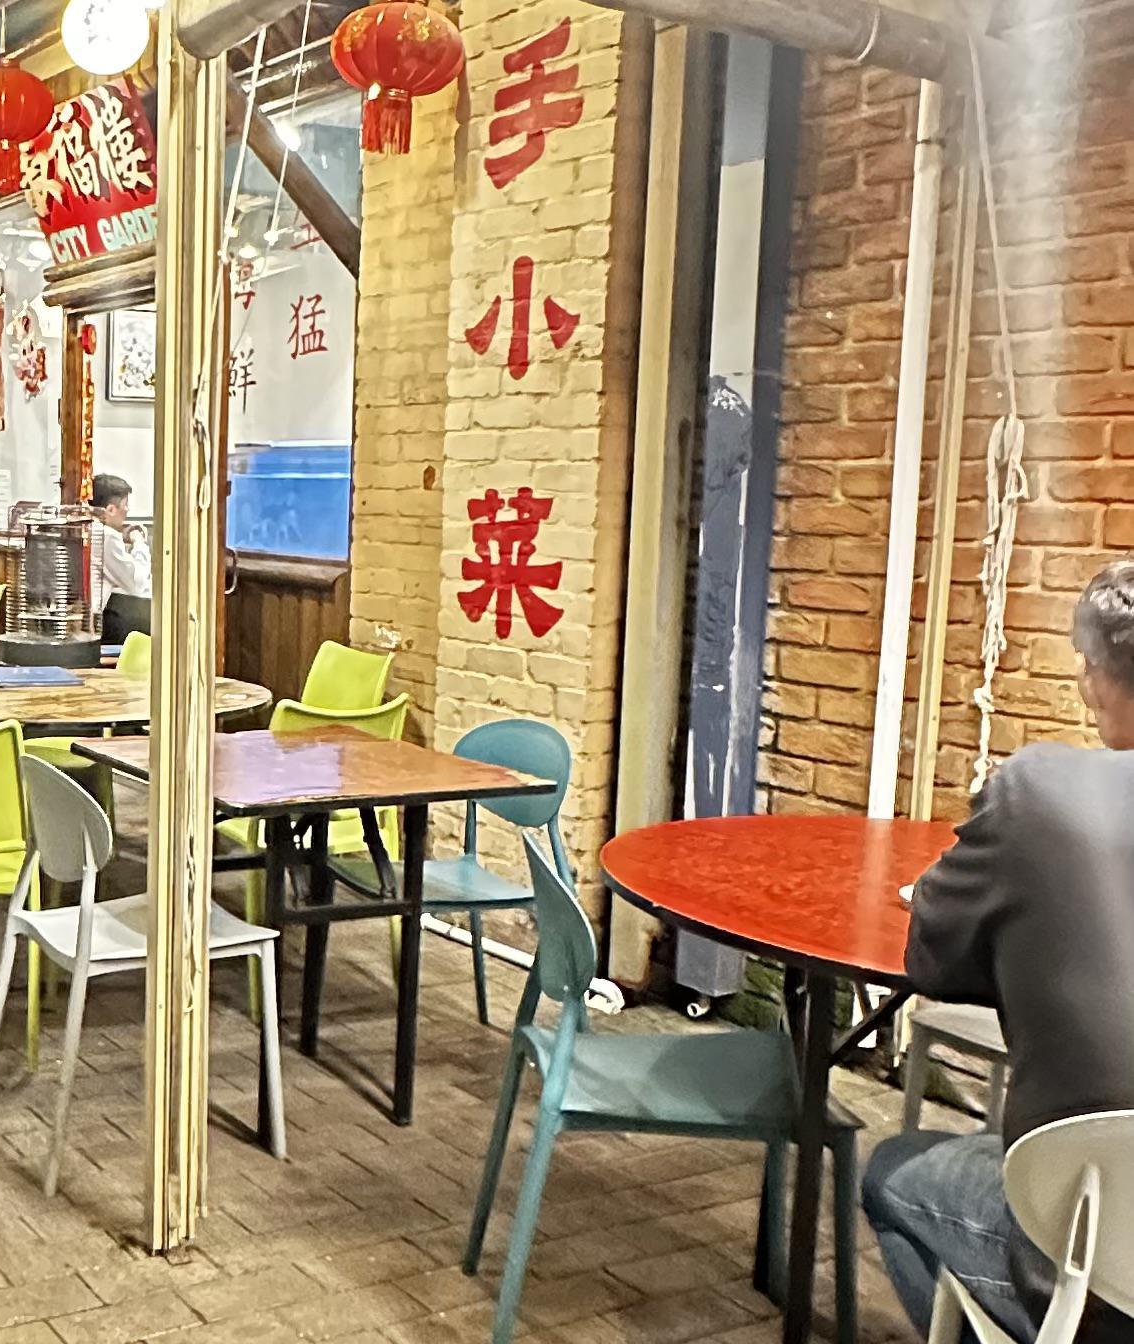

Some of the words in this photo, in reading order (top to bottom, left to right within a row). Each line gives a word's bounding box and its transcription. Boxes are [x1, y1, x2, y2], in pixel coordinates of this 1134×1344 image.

[49, 224, 91, 264] CITY
[97, 205, 158, 252] GARDE
[457, 17, 584, 639] 手小菜
